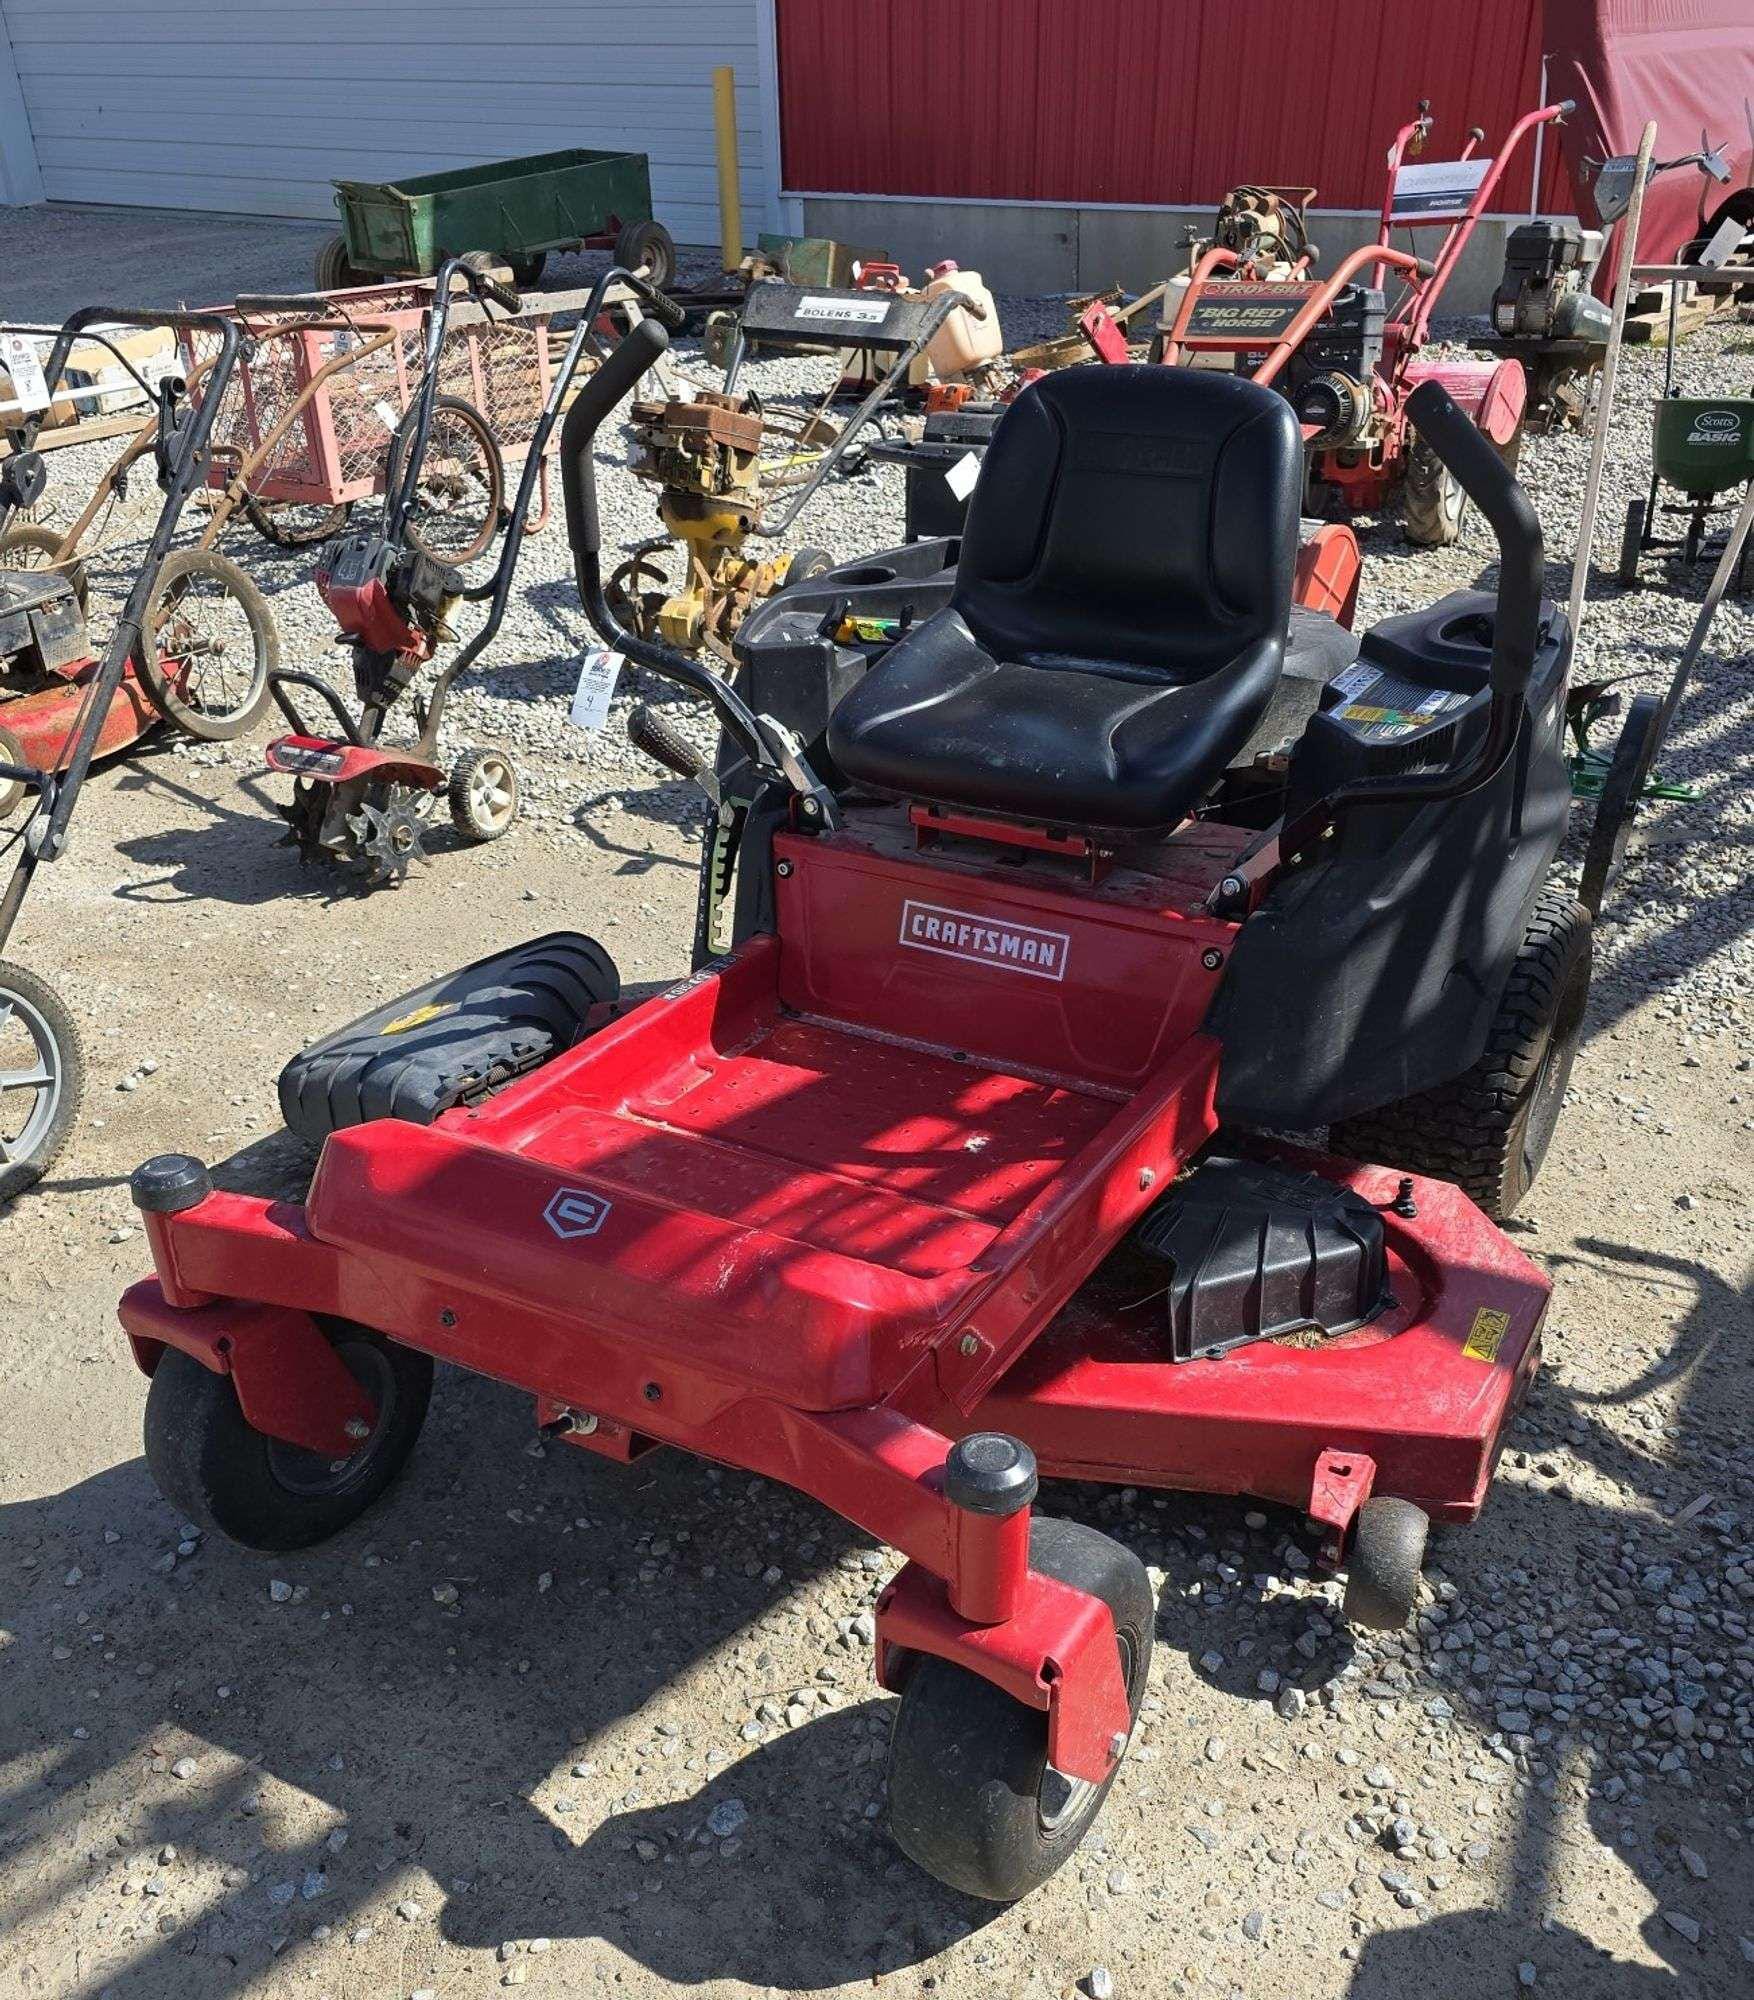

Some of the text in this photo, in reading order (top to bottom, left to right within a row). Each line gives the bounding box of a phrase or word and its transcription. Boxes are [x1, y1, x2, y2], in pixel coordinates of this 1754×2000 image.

[1220, 284, 1313, 295] TROY-BILT
[802, 308, 851, 318] BOLENS
[1211, 319, 1277, 328] HORSE
[1701, 415, 1734, 428] Scotts
[1686, 432, 1742, 442] BASIC
[911, 914, 1056, 966] CRAFTSMAN
